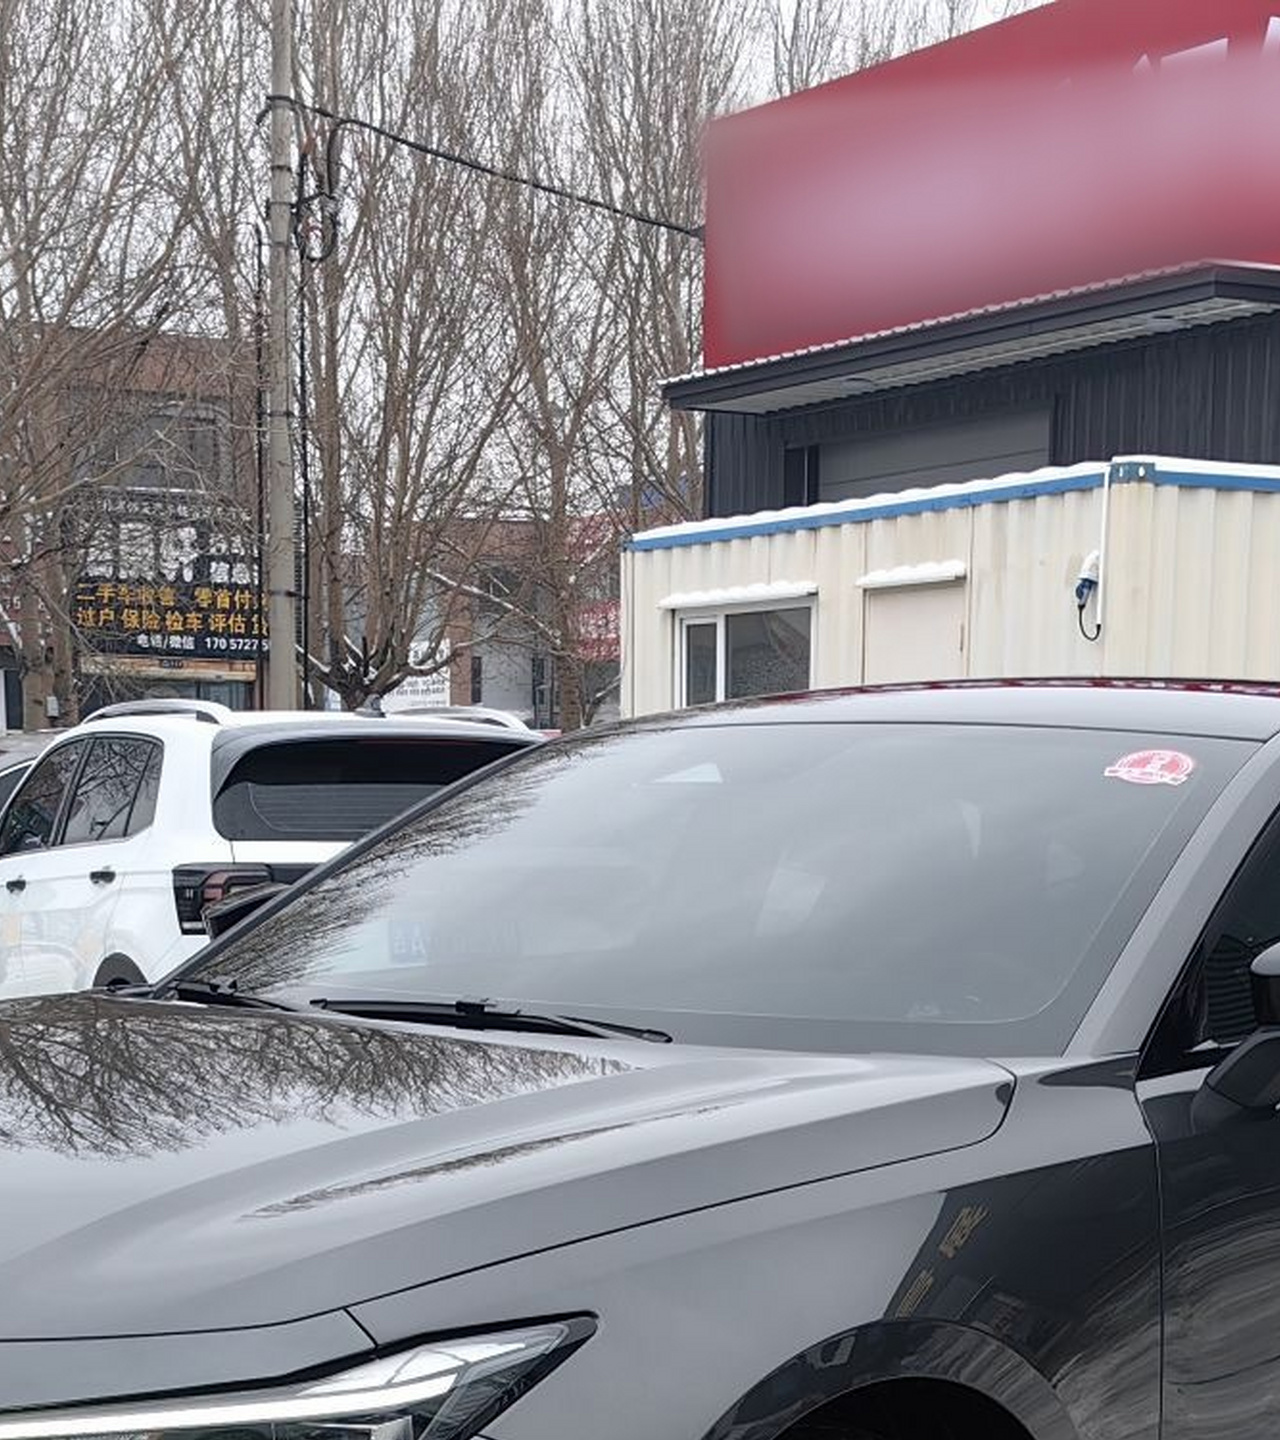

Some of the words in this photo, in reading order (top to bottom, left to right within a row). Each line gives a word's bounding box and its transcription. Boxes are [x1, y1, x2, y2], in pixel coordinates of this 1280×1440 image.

[121, 608, 161, 631] 保险
[166, 612, 204, 632] 检车
[210, 613, 247, 634] 评估
